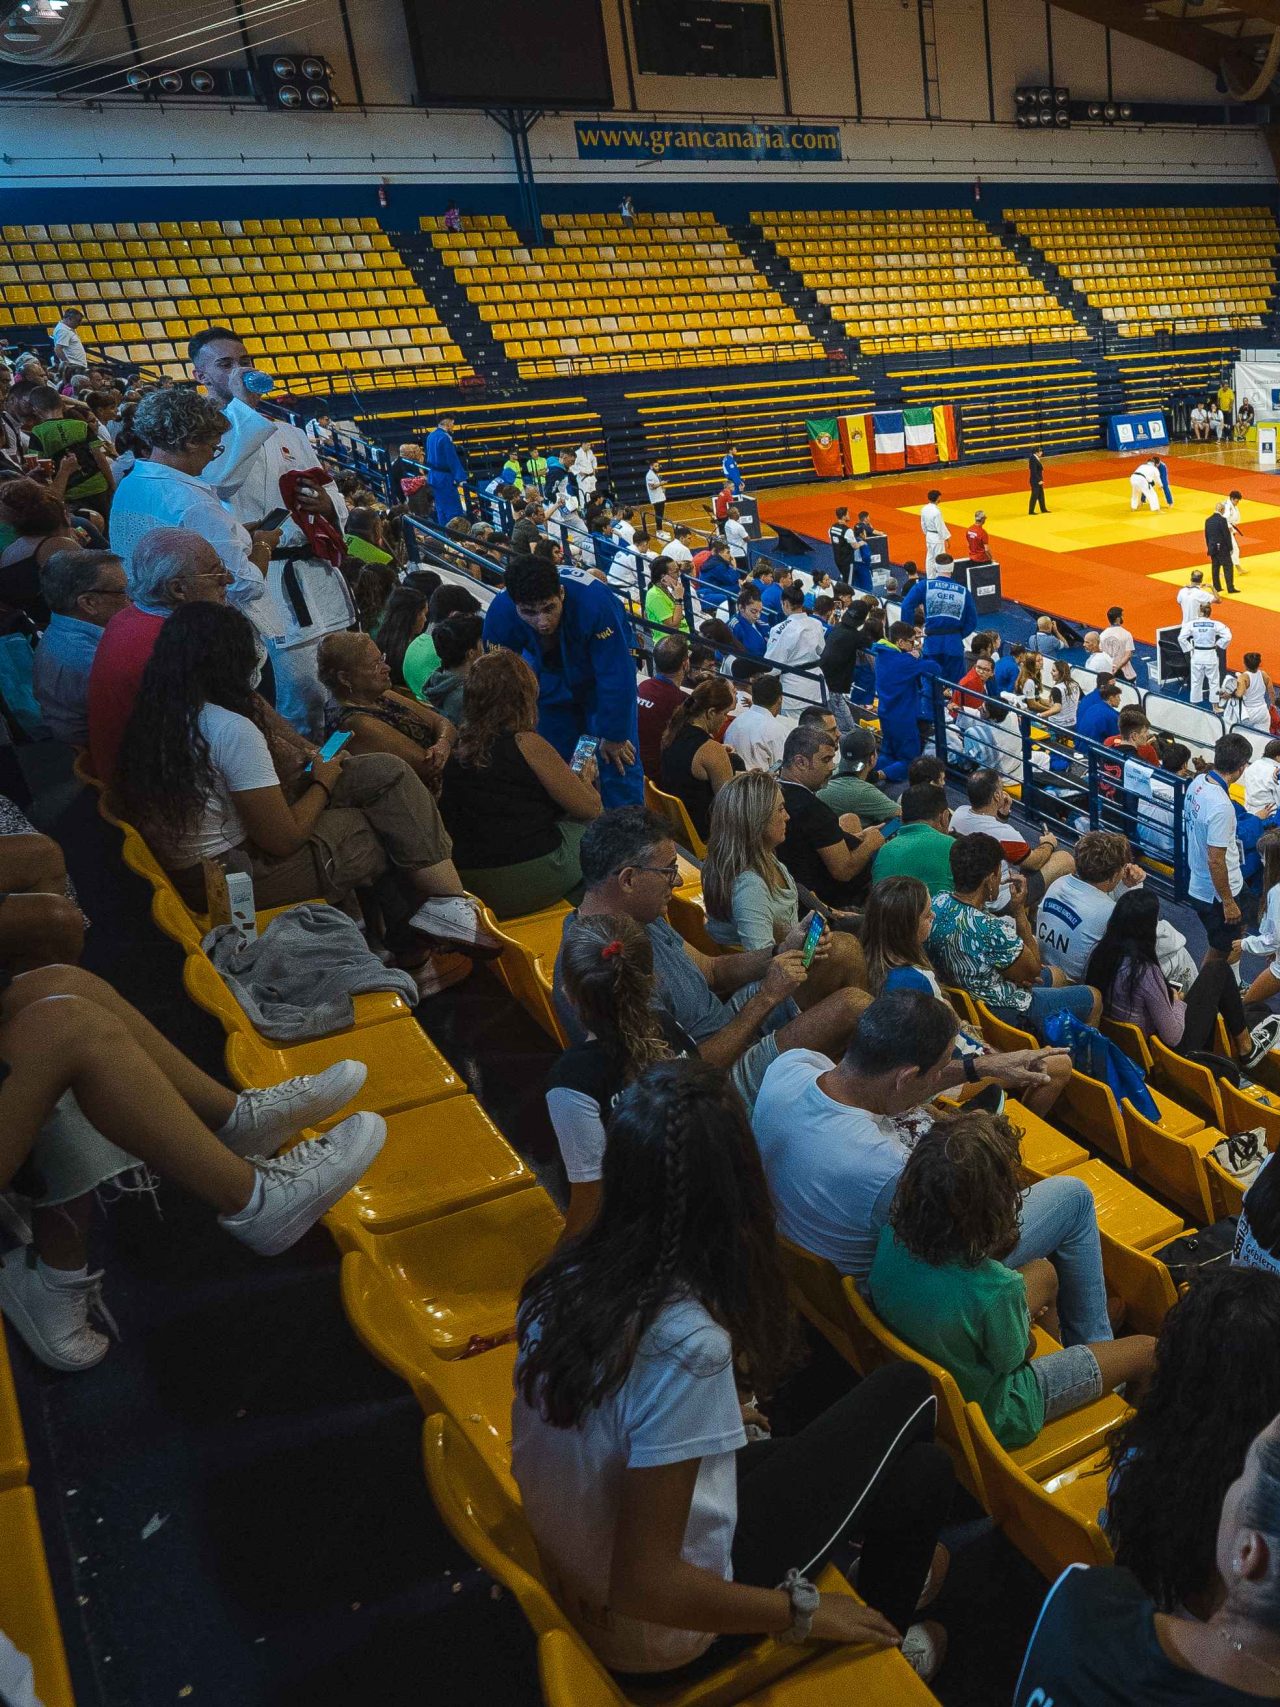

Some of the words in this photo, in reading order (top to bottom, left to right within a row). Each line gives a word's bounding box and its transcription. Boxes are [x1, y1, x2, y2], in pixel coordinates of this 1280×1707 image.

[579, 125, 838, 154] www.grancanaria.com
[936, 591, 955, 601] GER
[1038, 922, 1070, 954] CAN
